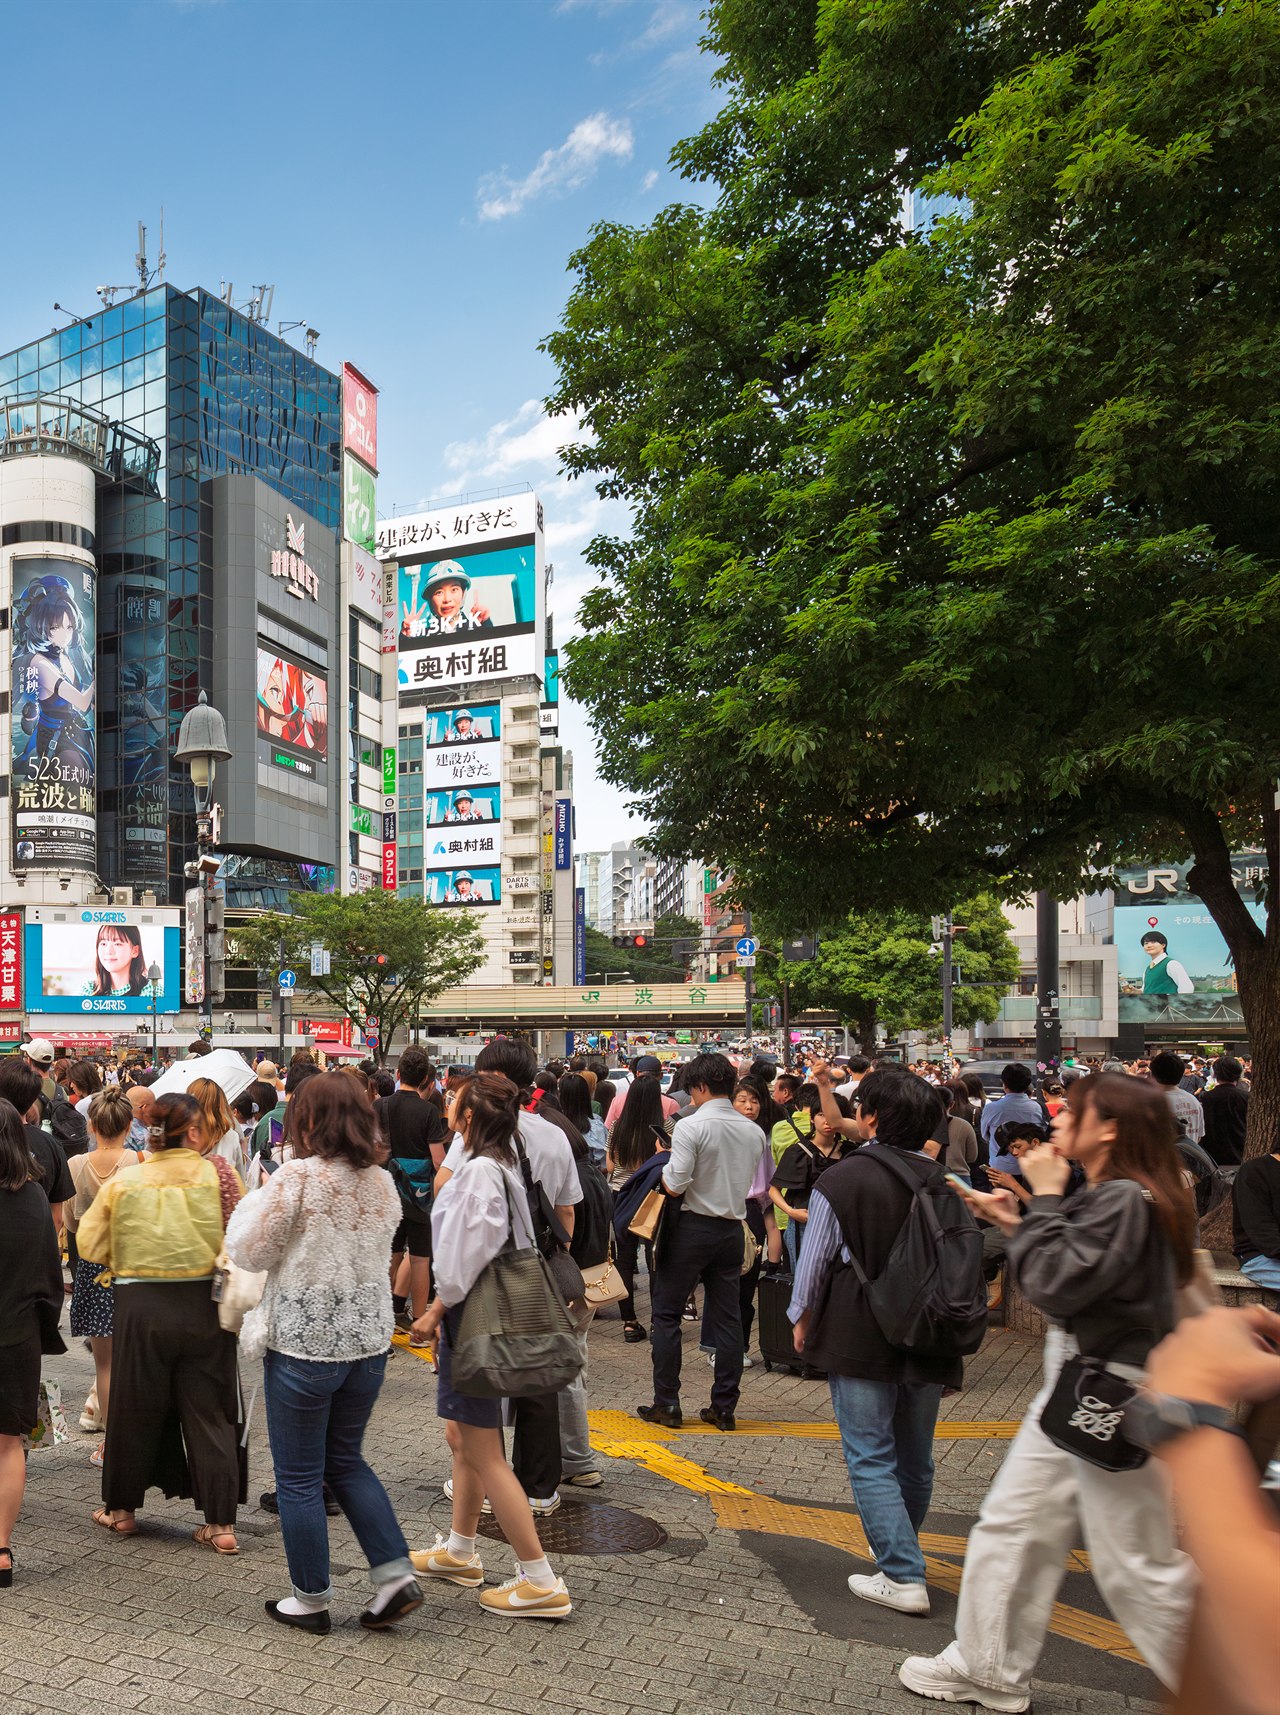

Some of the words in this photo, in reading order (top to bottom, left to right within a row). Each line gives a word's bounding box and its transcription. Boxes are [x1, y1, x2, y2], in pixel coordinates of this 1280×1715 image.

[378, 507, 517, 550] 建設が、好きだ。
[414, 644, 508, 683] 奥村組
[385, 752, 393, 776] レイク
[558, 804, 566, 833] MIZUHO
[448, 837, 494, 854] 奥村組
[386, 860, 394, 884] アコム
[506, 876, 529, 884] DARTS
[1128, 869, 1178, 895] JR
[1, 930, 17, 1003] 天津甘栗
[581, 991, 600, 1001] JR
[634, 987, 708, 1005] 渋谷
